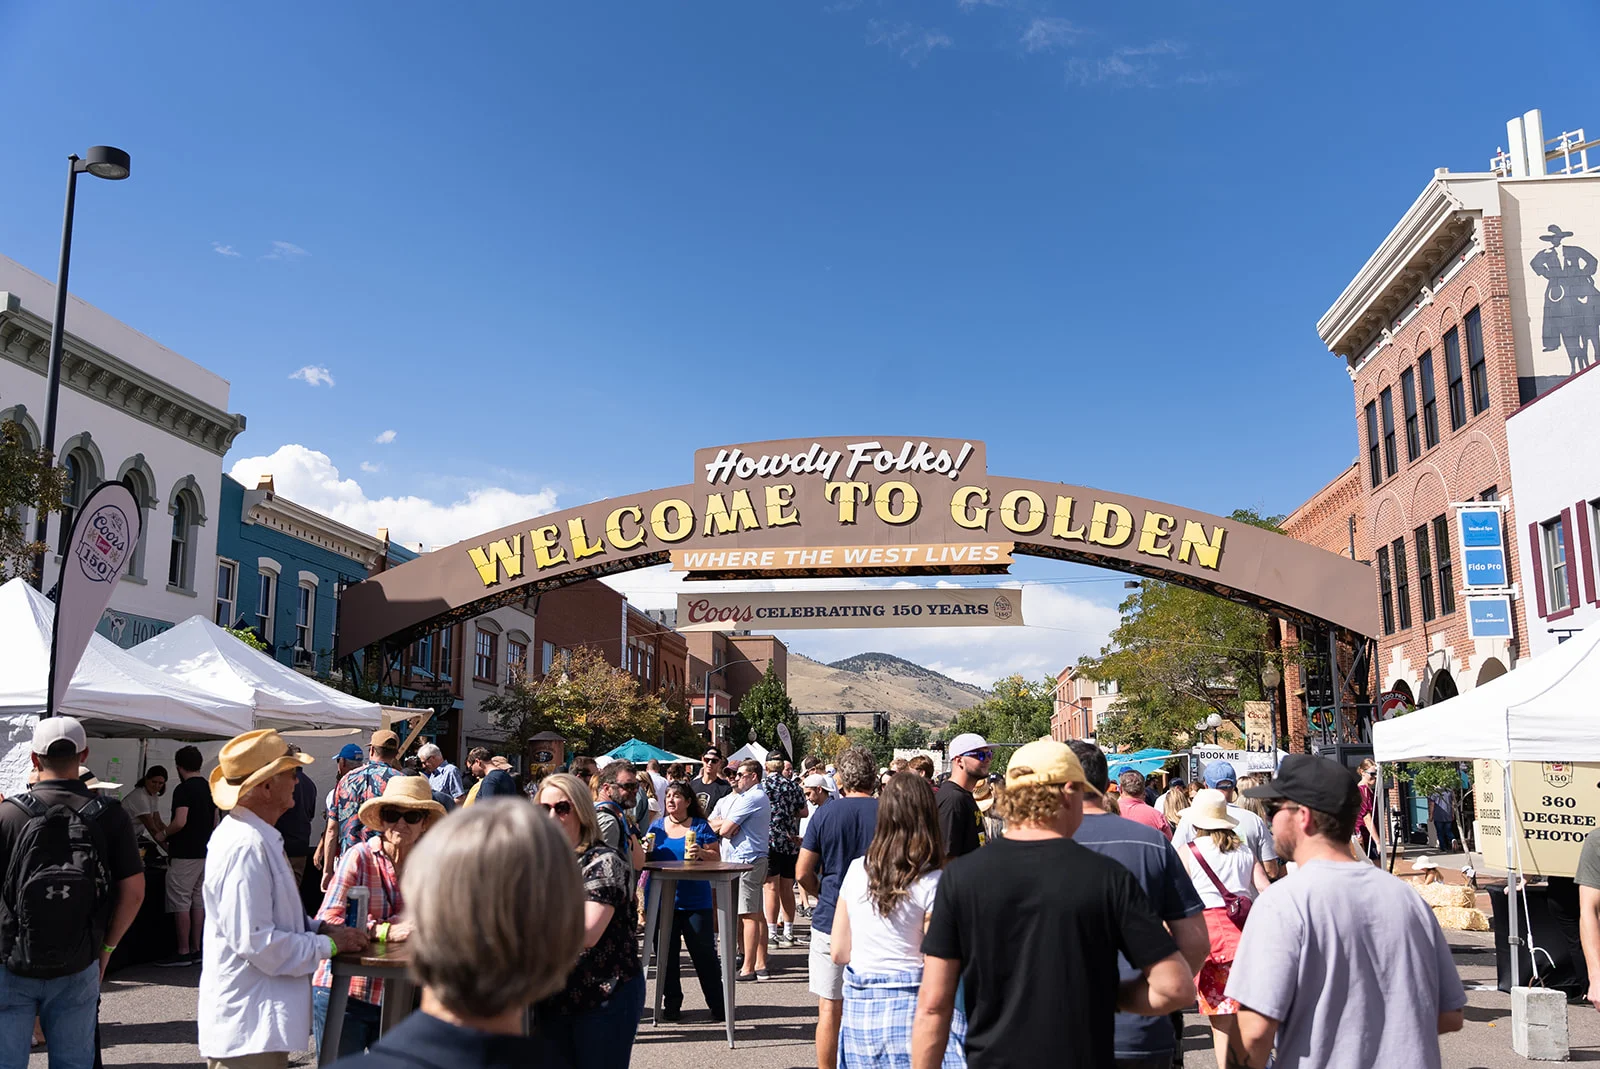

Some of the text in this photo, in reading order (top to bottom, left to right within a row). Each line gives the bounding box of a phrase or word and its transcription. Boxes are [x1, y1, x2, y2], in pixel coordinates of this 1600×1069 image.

[705, 441, 974, 484] Howdy Folks!
[93, 512, 126, 551] Coors
[466, 481, 1228, 587] WELCOME TO GOLDEN
[83, 549, 108, 575] 150
[683, 546, 999, 568] WHERE THE WEST LIVES
[1468, 563, 1502, 571] Fido Pro
[688, 599, 989, 623] Coors CELEBRATING 150 YEARS
[415, 696, 453, 705] SADDLE
[1395, 693, 1407, 701] PRO
[1200, 752, 1240, 760] BOOK ME
[1549, 774, 1567, 782] 150
[1542, 795, 1576, 808] 360
[1522, 811, 1596, 827] DEGREE
[1524, 829, 1588, 843] PHOTO
